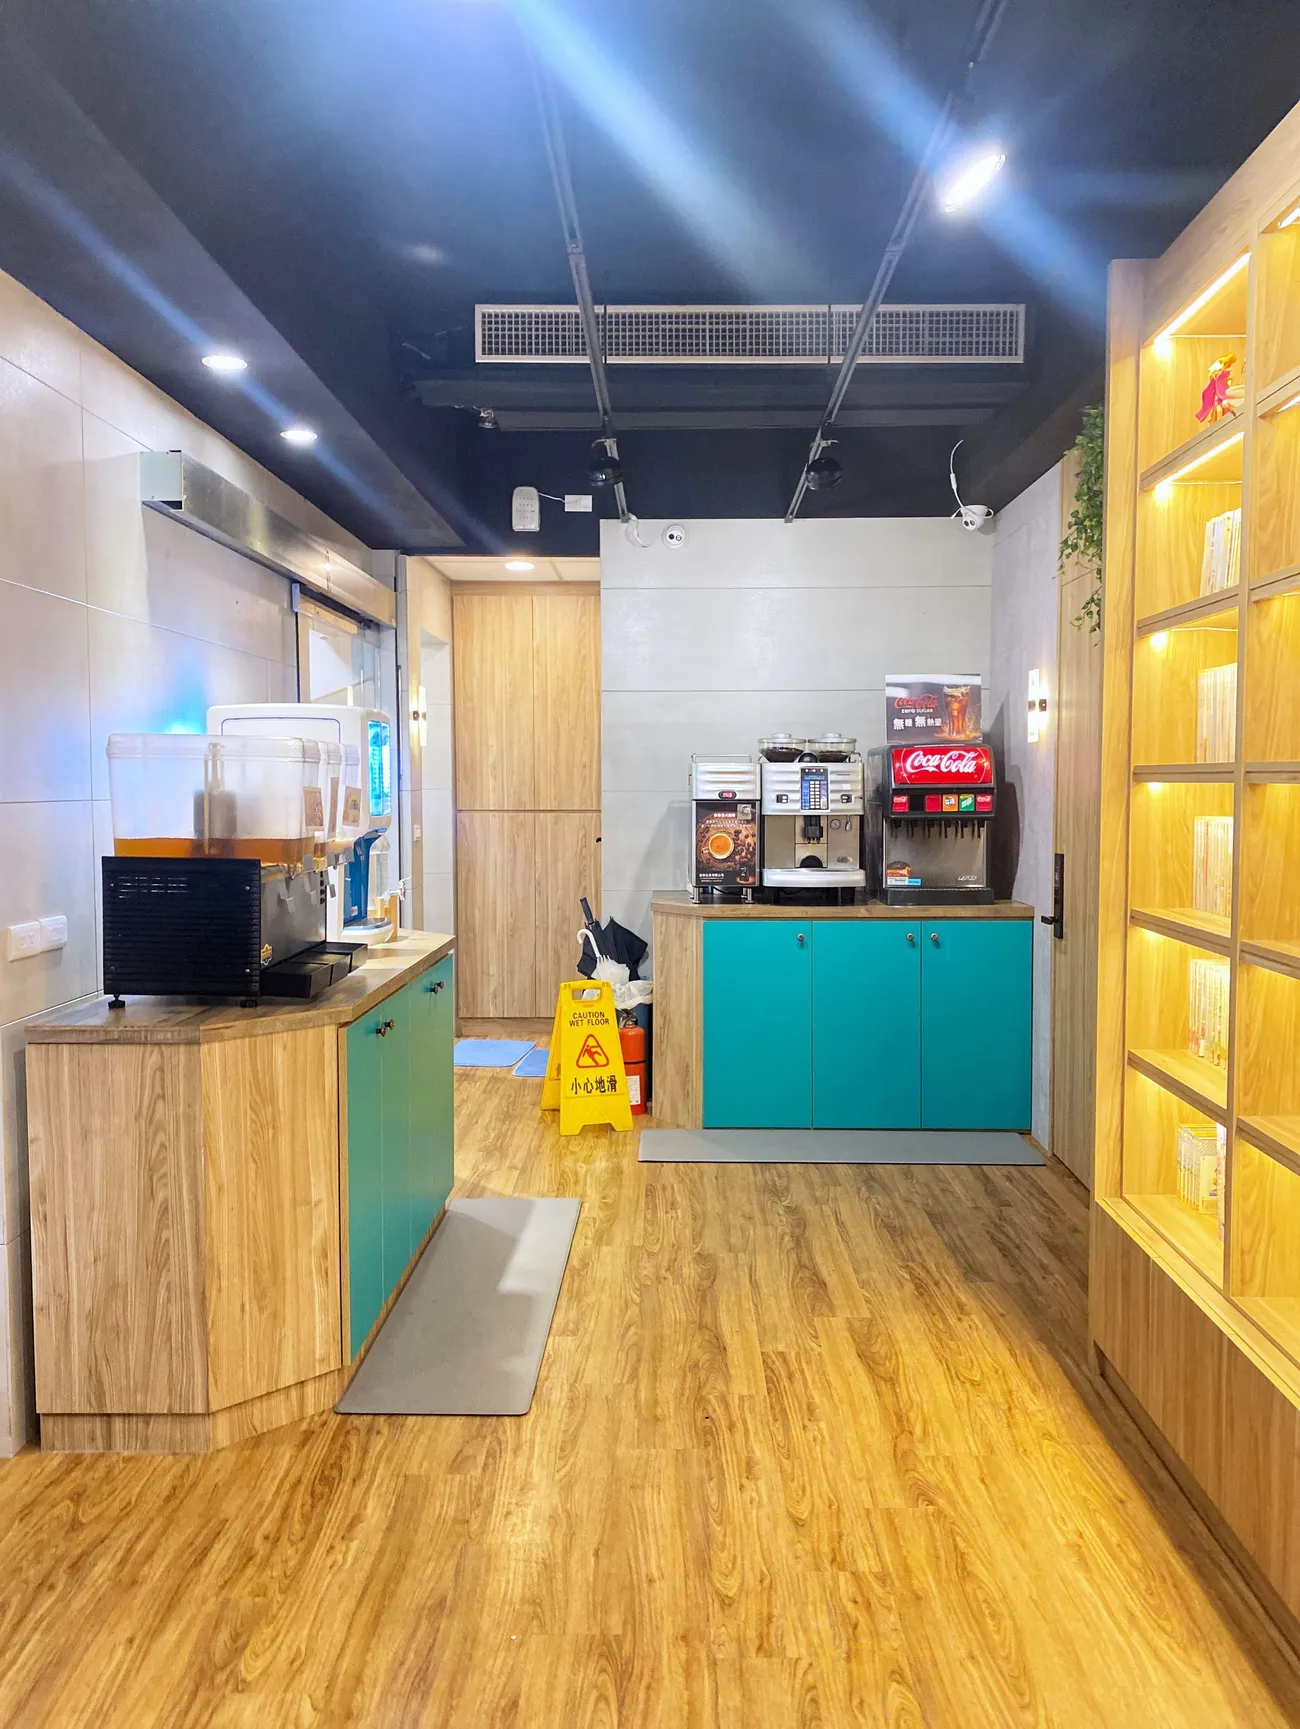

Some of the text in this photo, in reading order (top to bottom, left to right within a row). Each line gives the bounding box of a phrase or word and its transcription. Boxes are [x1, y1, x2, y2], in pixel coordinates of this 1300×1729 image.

[905, 750, 980, 773] Coca-Cola
[572, 1011, 605, 1019] CAUTION
[569, 1019, 584, 1027] WET
[571, 1075, 617, 1095] 小心地滑
